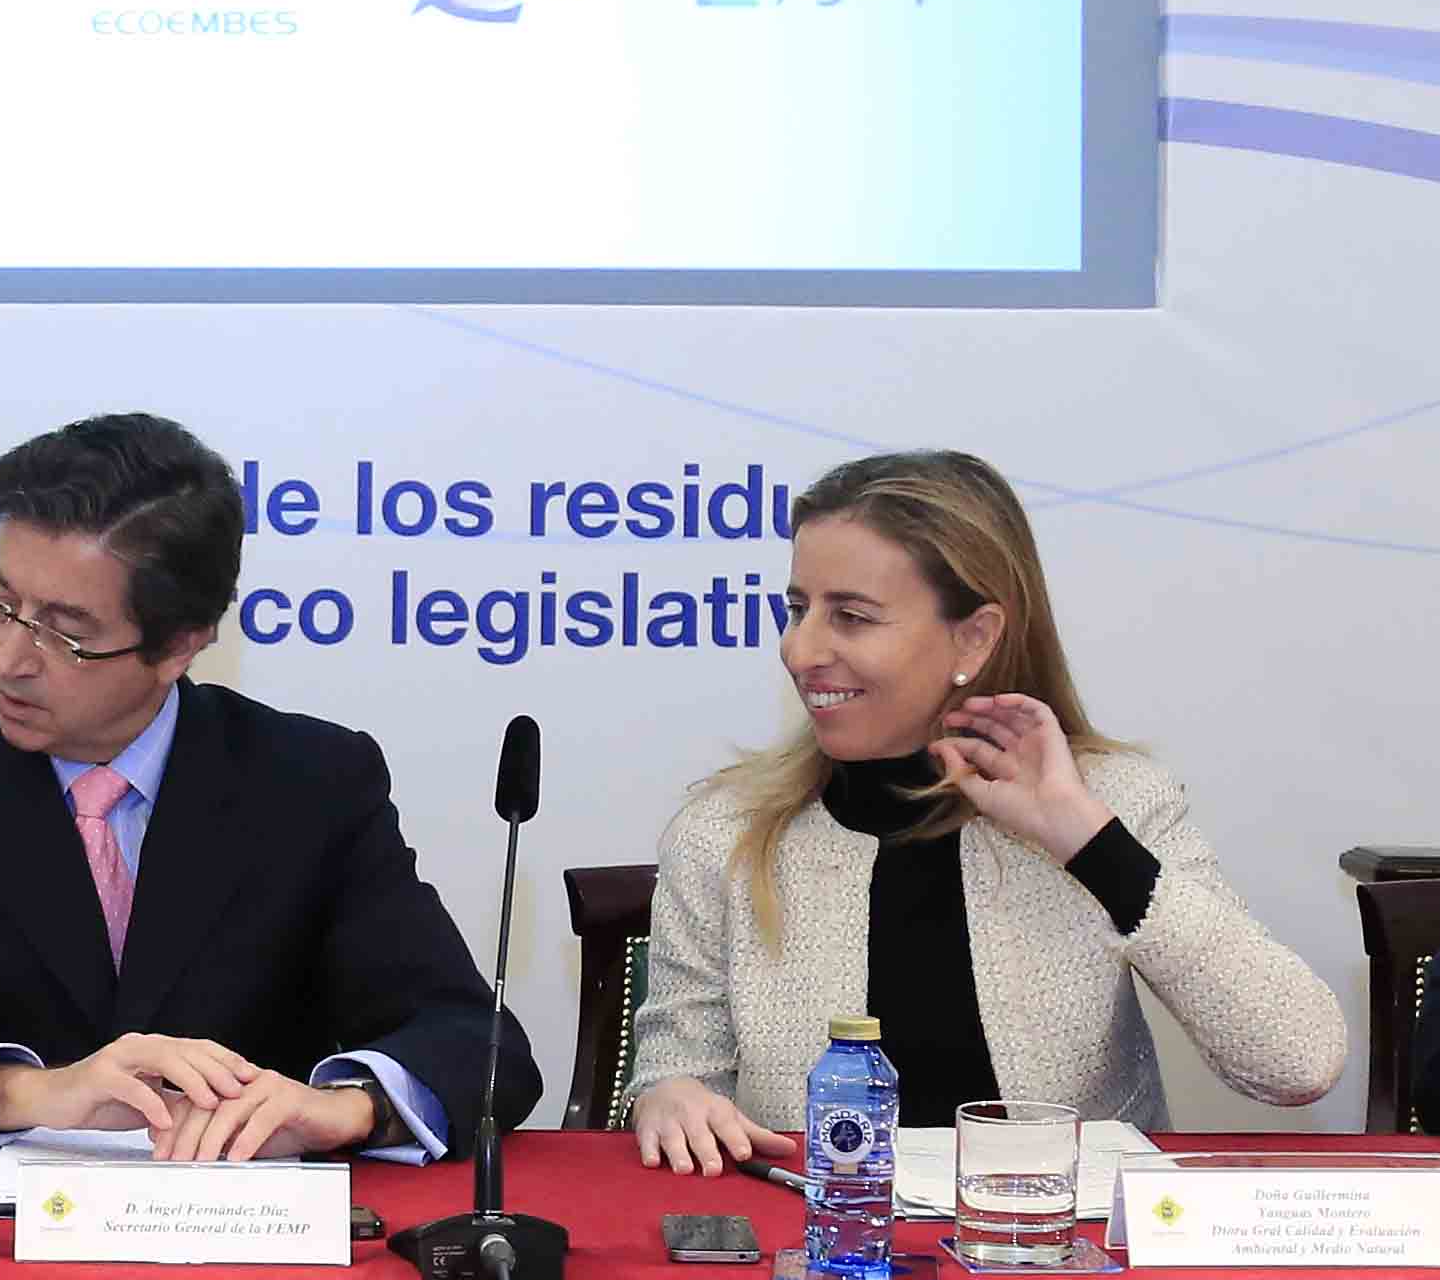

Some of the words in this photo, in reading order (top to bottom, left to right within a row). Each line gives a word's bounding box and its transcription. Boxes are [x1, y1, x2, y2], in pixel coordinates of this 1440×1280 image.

[91, 9, 299, 37] ECOEMBES
[355, 460, 495, 538] los
[528, 463, 794, 540] resid
[390, 569, 789, 666] legislati
[821, 1109, 873, 1145] MONDARIZ
[103, 1221, 170, 1233] Secretario
[174, 1221, 226, 1234] General
[230, 1222, 246, 1234] de
[248, 1222, 261, 1234] la
[265, 1223, 311, 1235] FEMP
